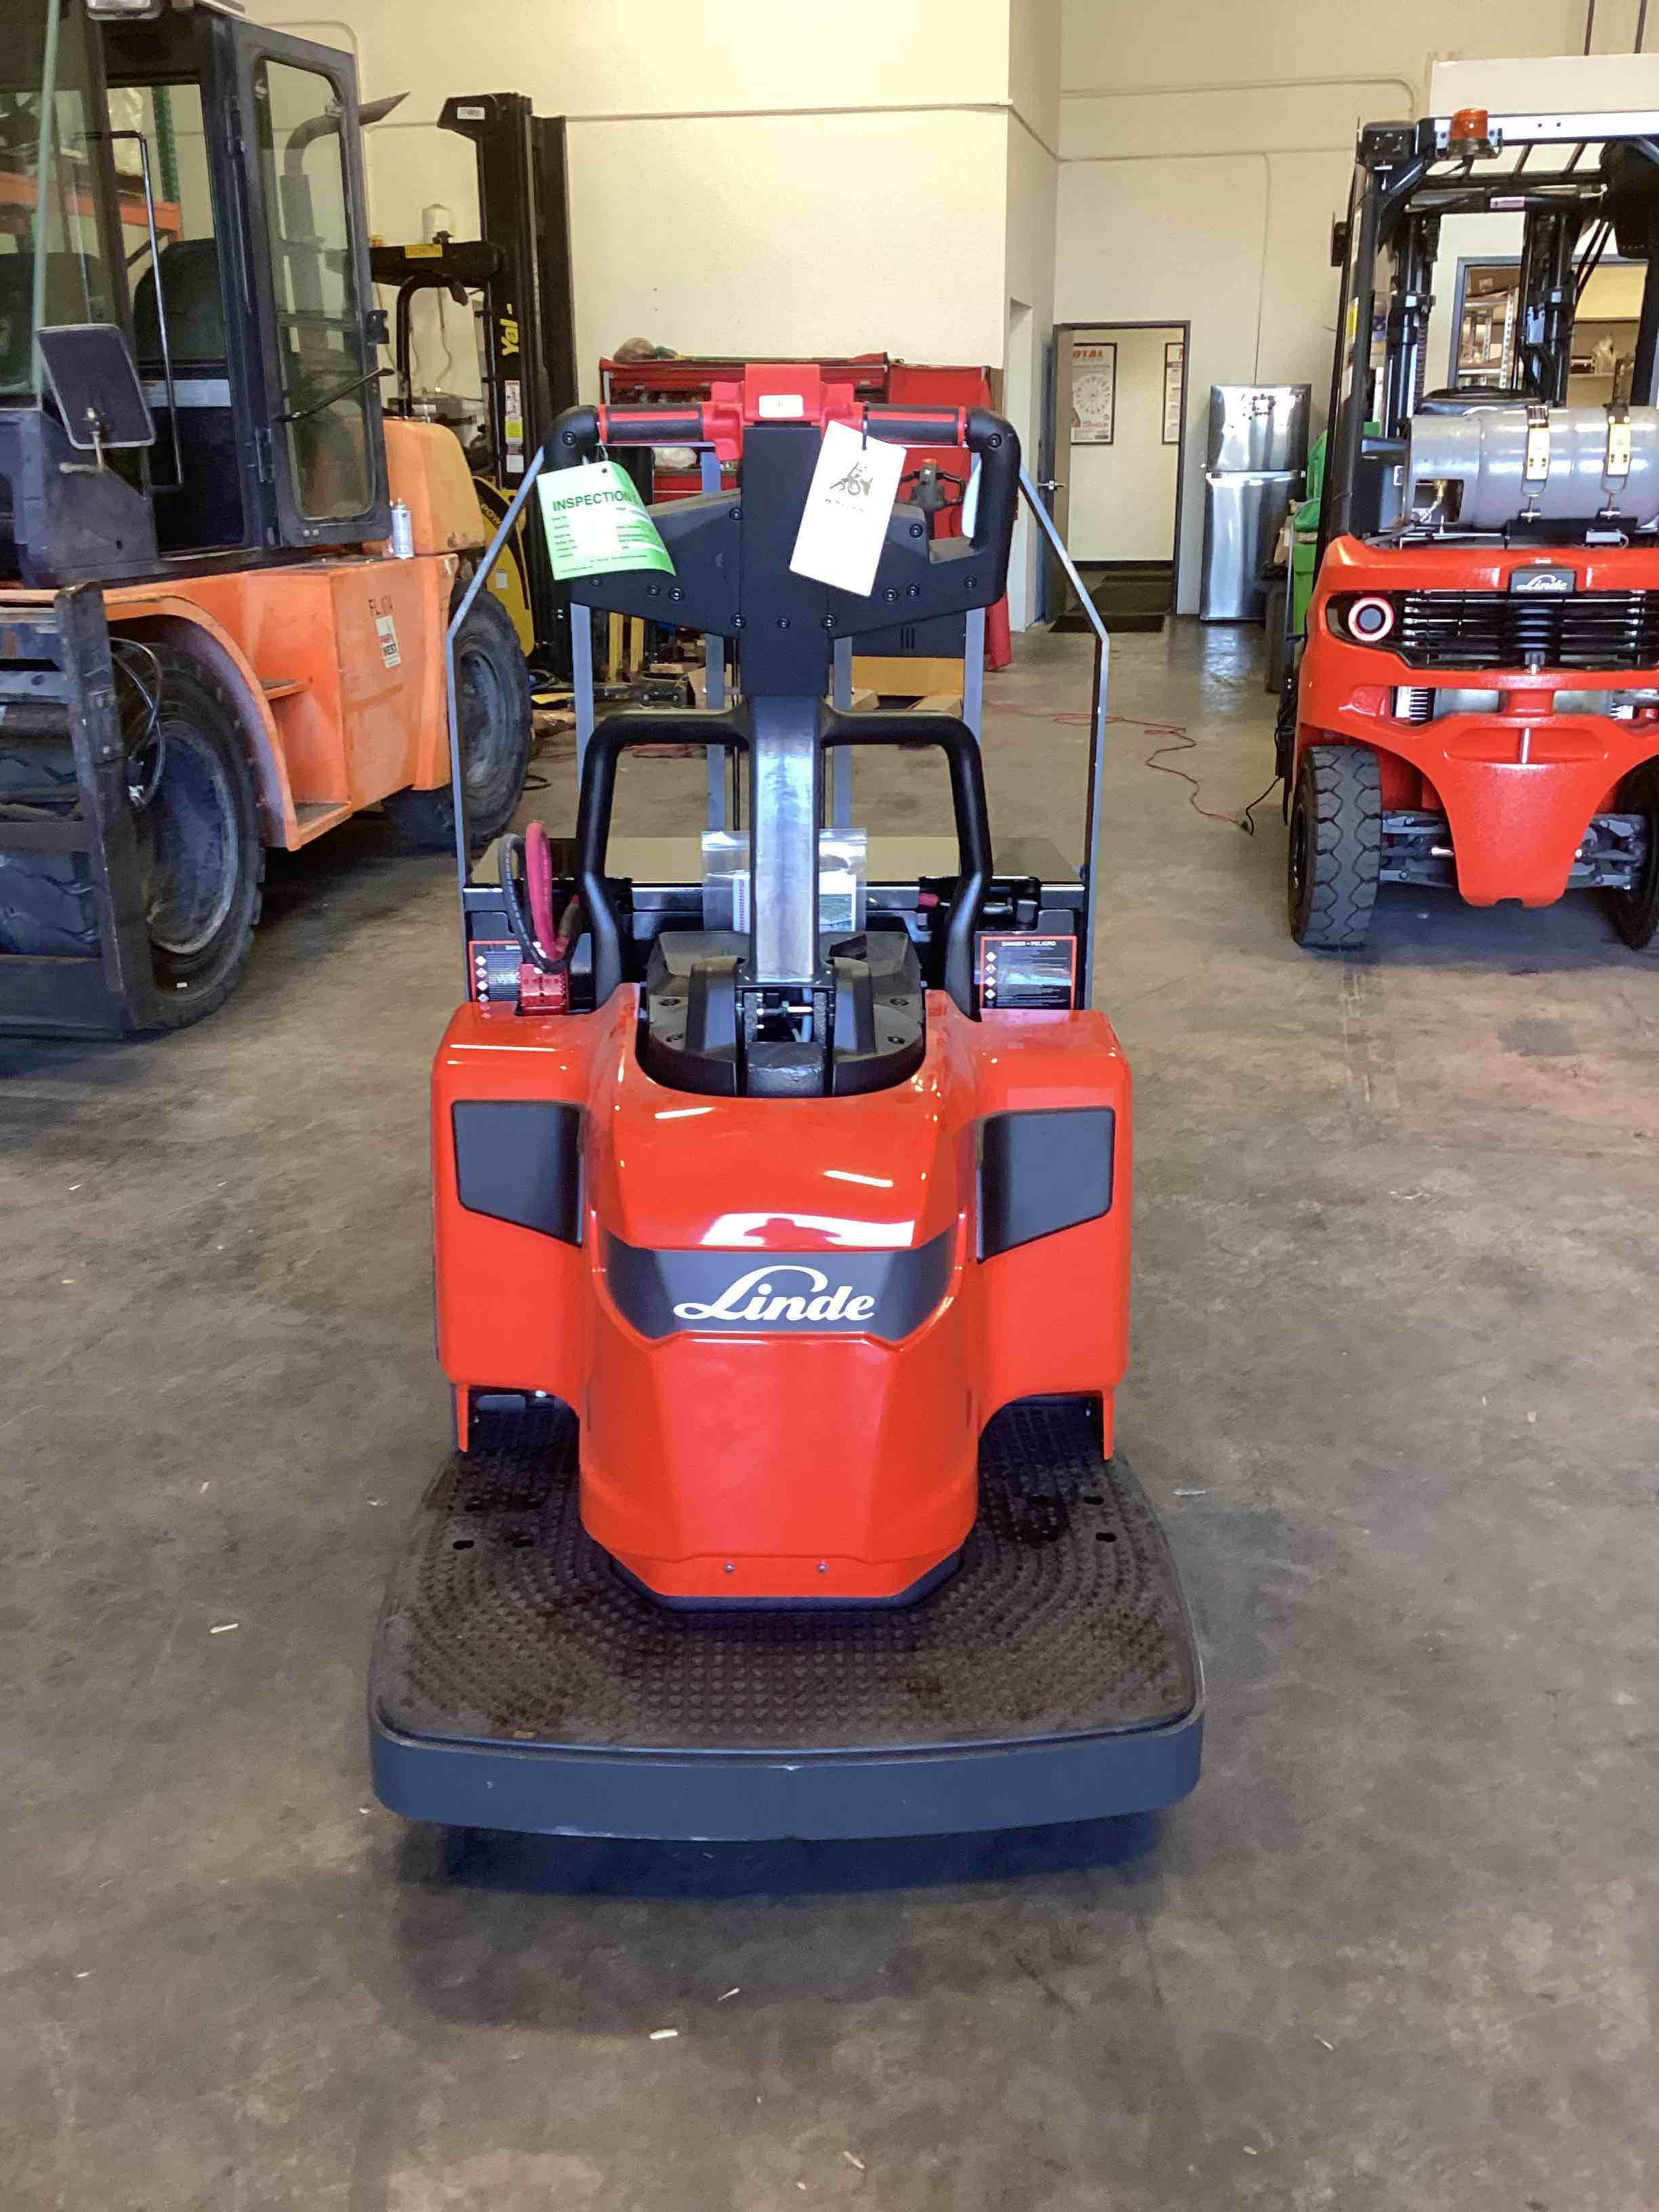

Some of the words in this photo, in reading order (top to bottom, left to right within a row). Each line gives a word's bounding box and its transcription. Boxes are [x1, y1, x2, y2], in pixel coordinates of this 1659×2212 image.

[499, 303, 519, 356] Yal
[552, 490, 634, 512] INSPECTION
[1516, 574, 1568, 591] Linde
[673, 1265, 875, 1321] Linde
